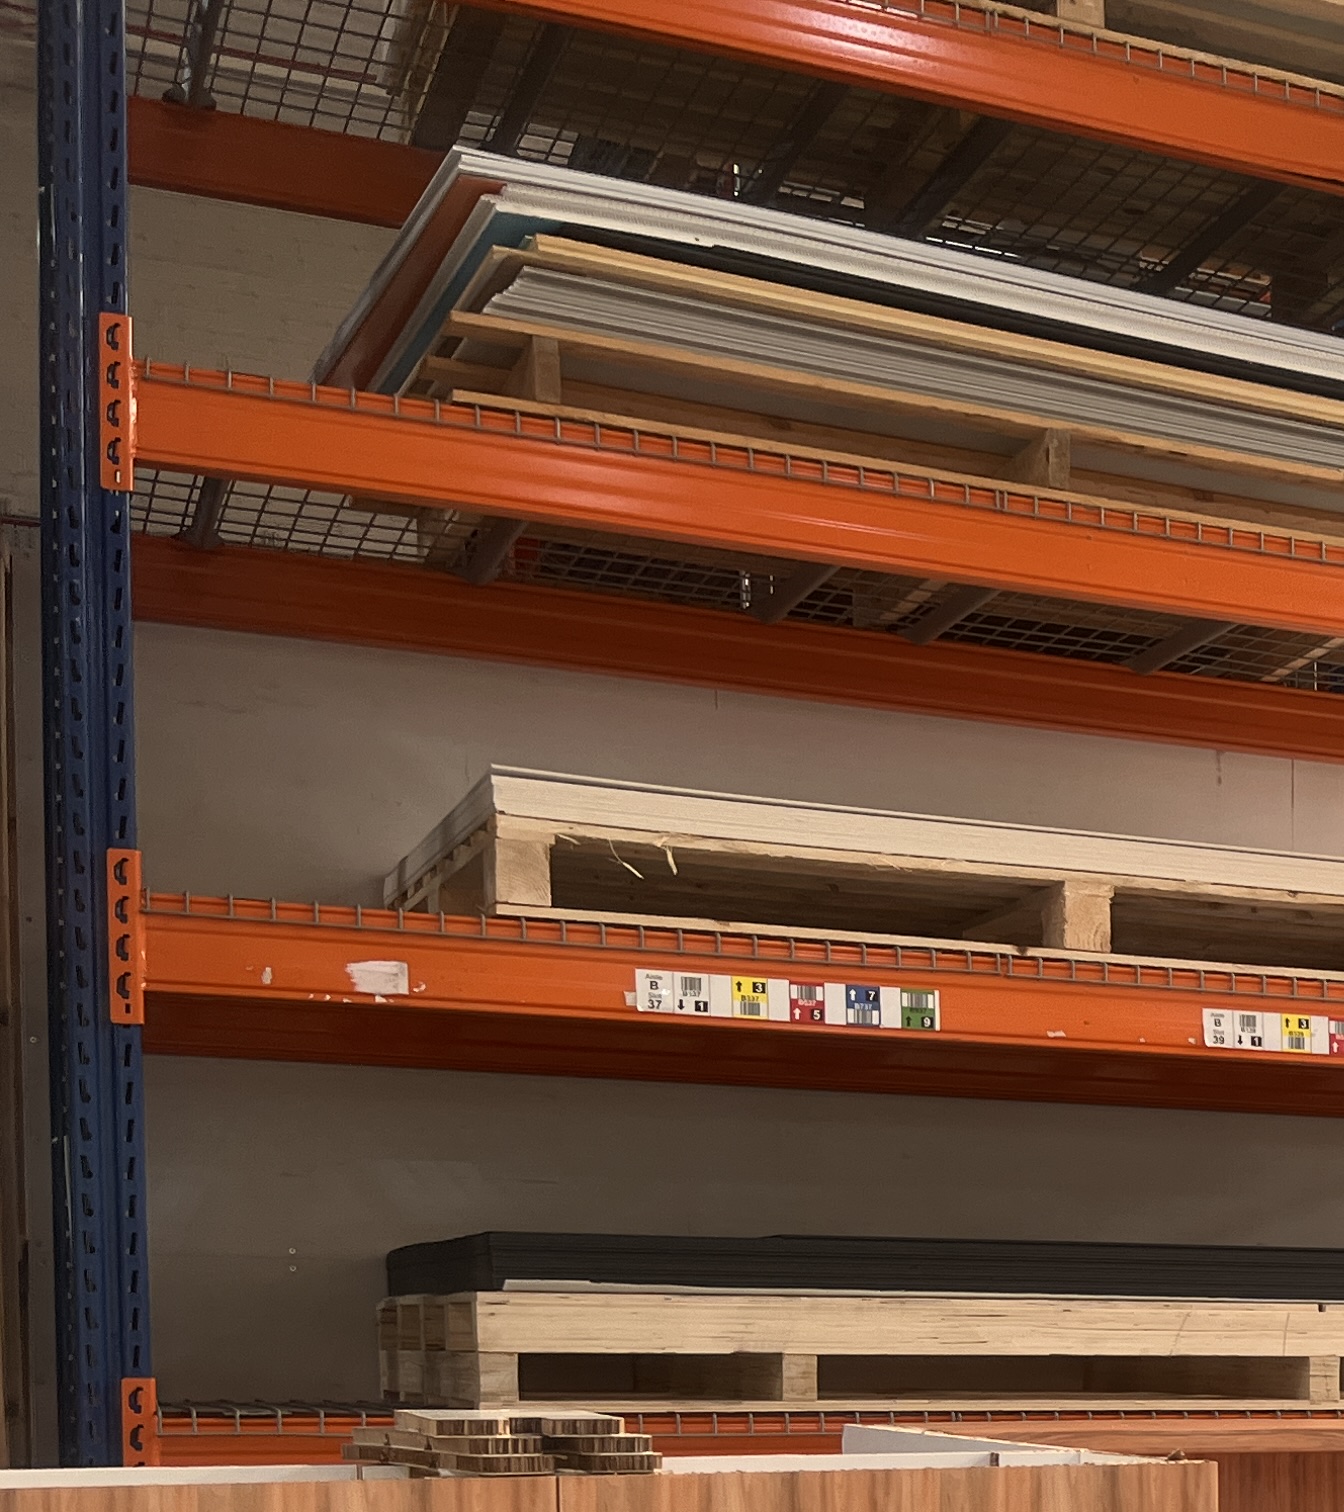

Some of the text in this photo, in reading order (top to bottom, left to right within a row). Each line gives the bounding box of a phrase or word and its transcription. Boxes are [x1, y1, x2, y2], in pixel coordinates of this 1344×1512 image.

[649, 981, 659, 990] B
[755, 983, 763, 993] 3
[868, 991, 876, 1001] 7
[648, 999, 662, 1010] 37
[813, 1010, 821, 1020] 5
[923, 1017, 931, 1027] 9
[1299, 1019, 1307, 1029] 3
[1213, 1035, 1225, 1045] 39
